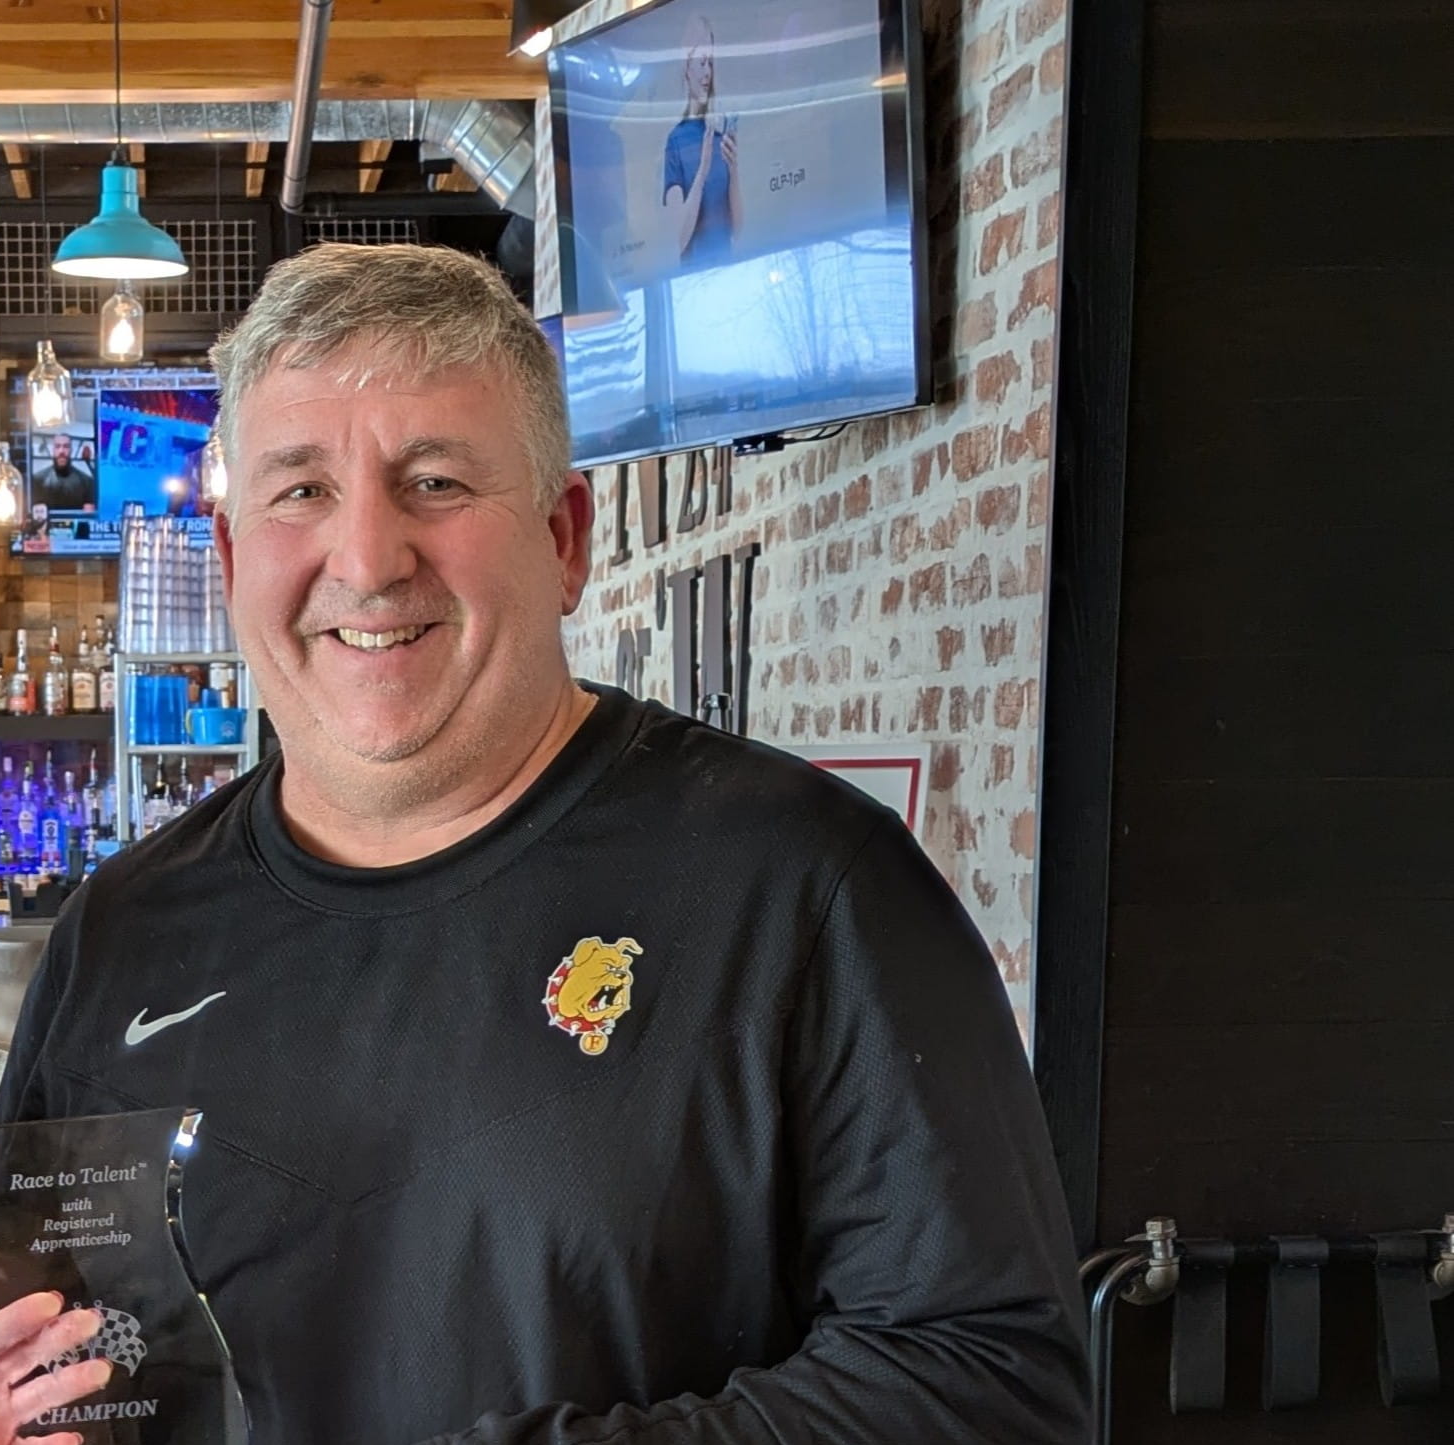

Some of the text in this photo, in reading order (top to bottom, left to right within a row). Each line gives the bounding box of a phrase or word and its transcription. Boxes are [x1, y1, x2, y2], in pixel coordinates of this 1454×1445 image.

[88, 521, 111, 532] THE
[589, 1035, 603, 1050] F
[9, 1173, 54, 1191] Race
[58, 1171, 76, 1186] to
[61, 1197, 93, 1213] with
[43, 1213, 115, 1233] Registered
[30, 1230, 132, 1253] Apprenticeship
[35, 1399, 160, 1426] CHAMPION
